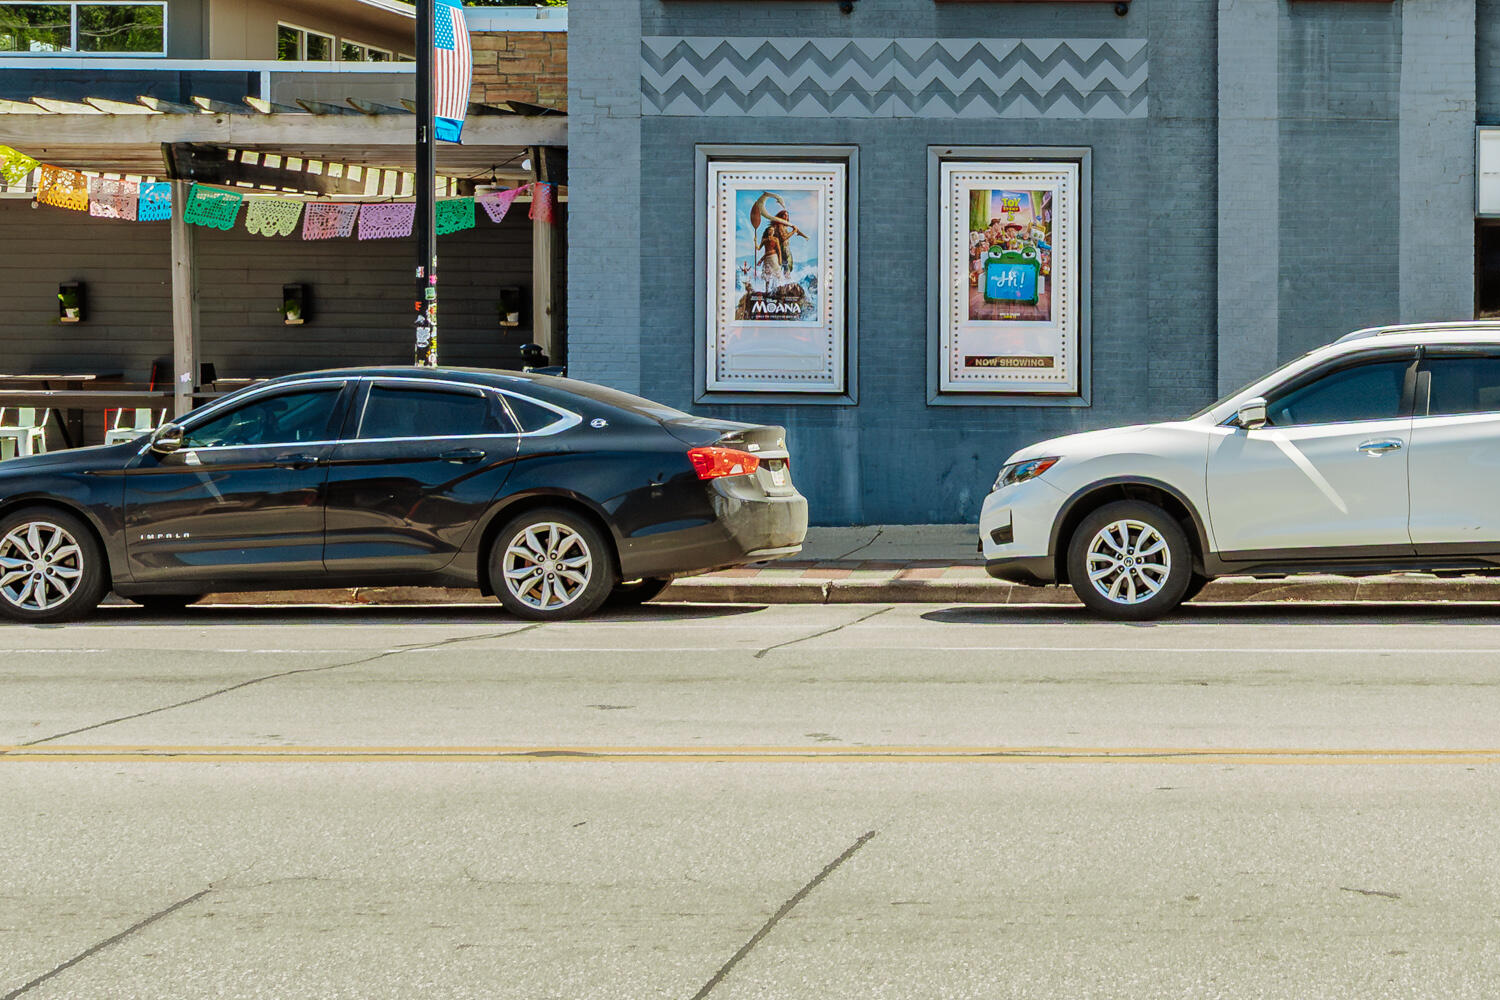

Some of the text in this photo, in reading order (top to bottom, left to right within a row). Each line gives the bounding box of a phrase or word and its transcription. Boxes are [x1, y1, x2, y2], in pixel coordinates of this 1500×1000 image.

[1001, 197, 1021, 207] TOY
[1007, 211, 1015, 221] 5
[751, 300, 802, 314] MOANA
[975, 358, 1045, 367] NOW SHOWING
[140, 532, 190, 540] IMPALA
